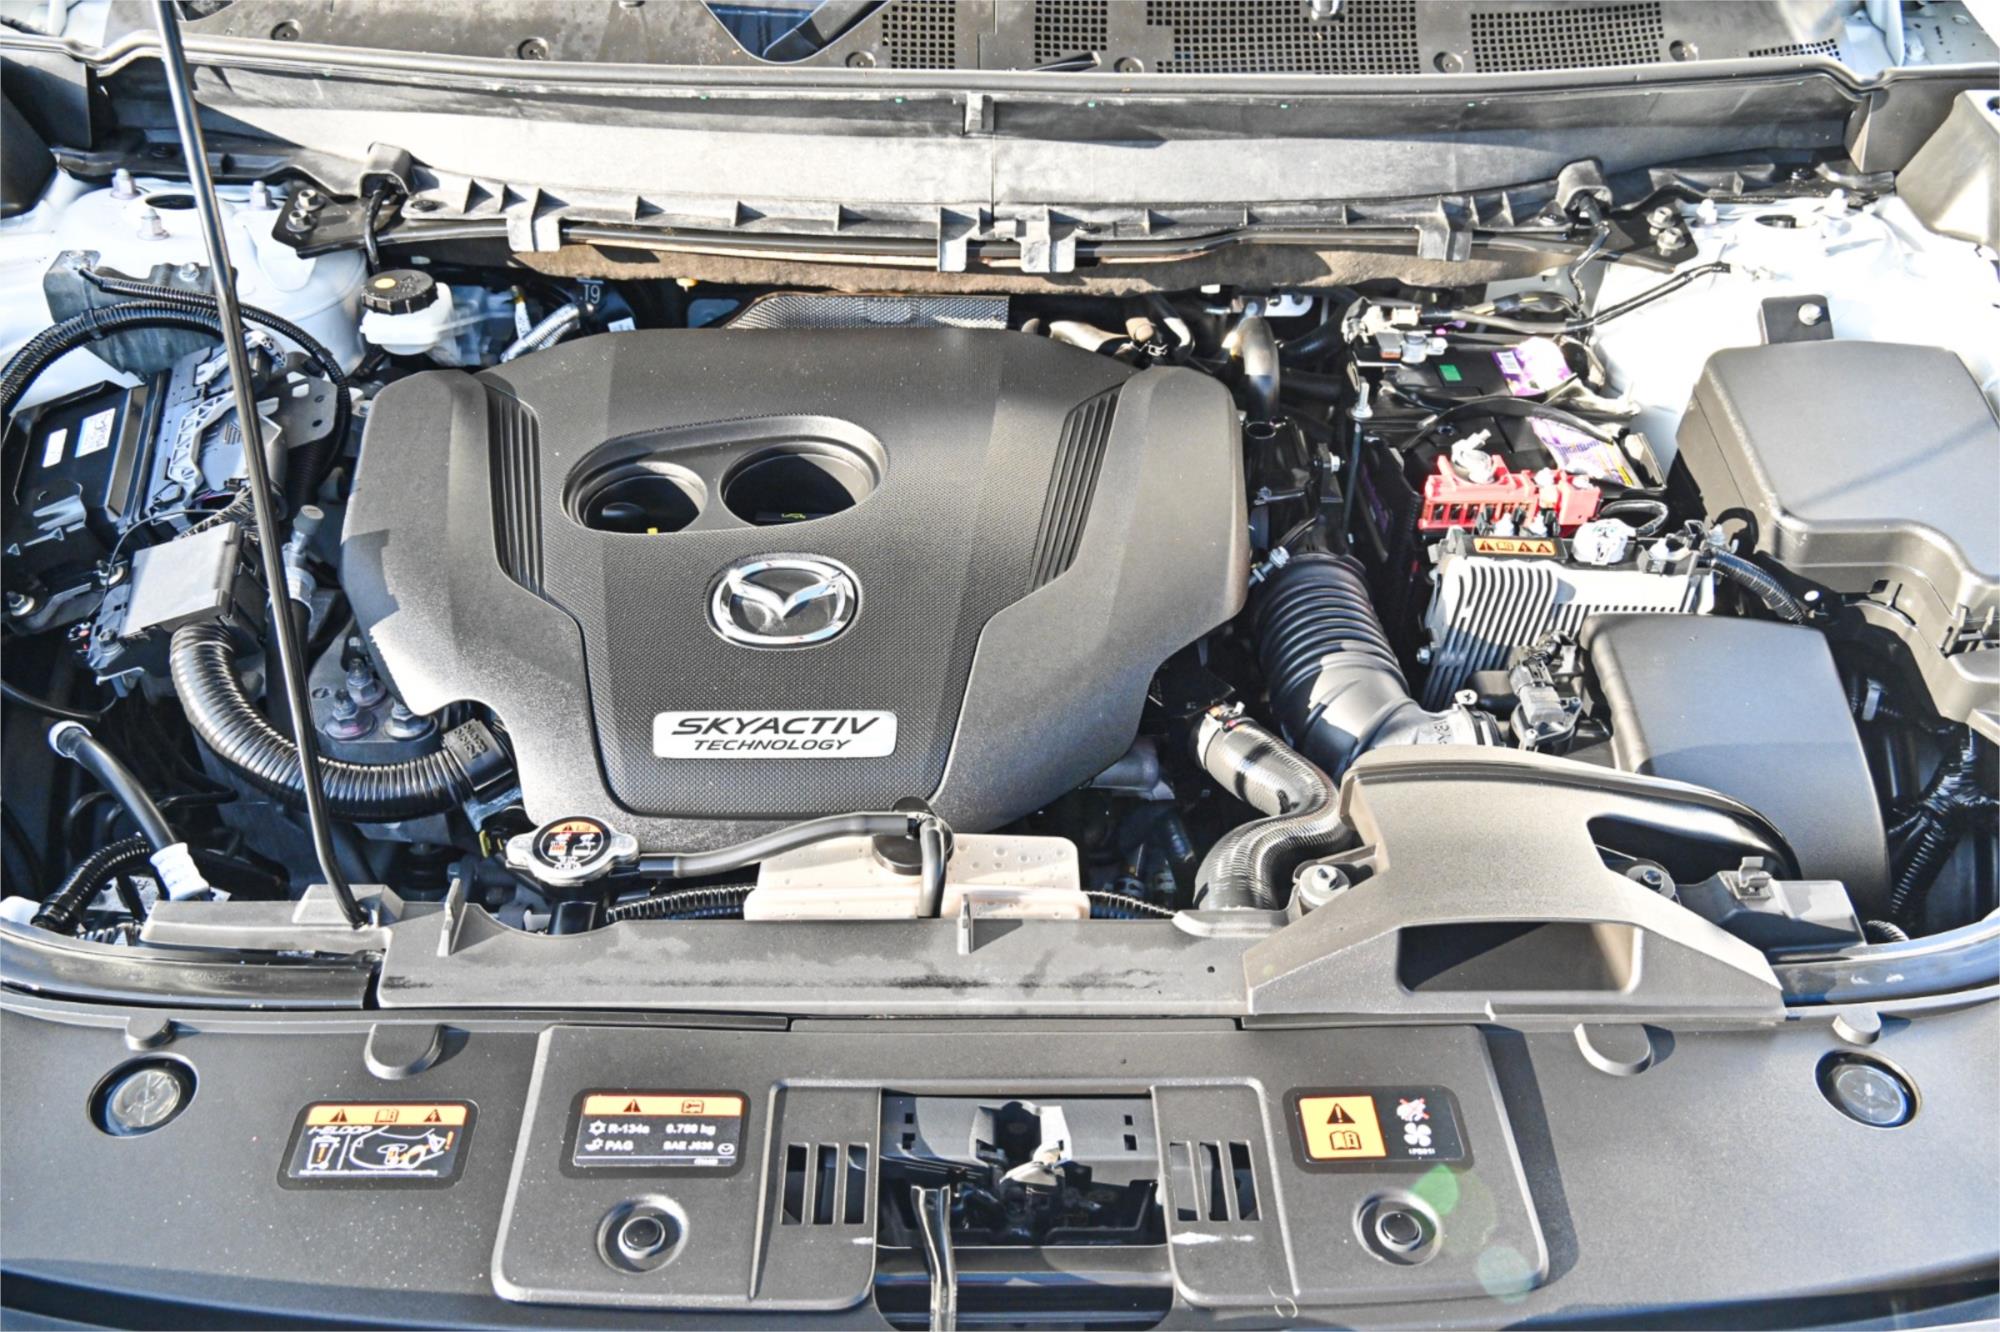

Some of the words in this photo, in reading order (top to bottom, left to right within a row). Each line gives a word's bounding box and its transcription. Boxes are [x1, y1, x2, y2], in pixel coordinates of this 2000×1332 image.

[672, 717, 880, 735] SKYACTIV
[694, 739, 851, 751] TECHNOLOGY
[604, 1140, 634, 1151] PAG
